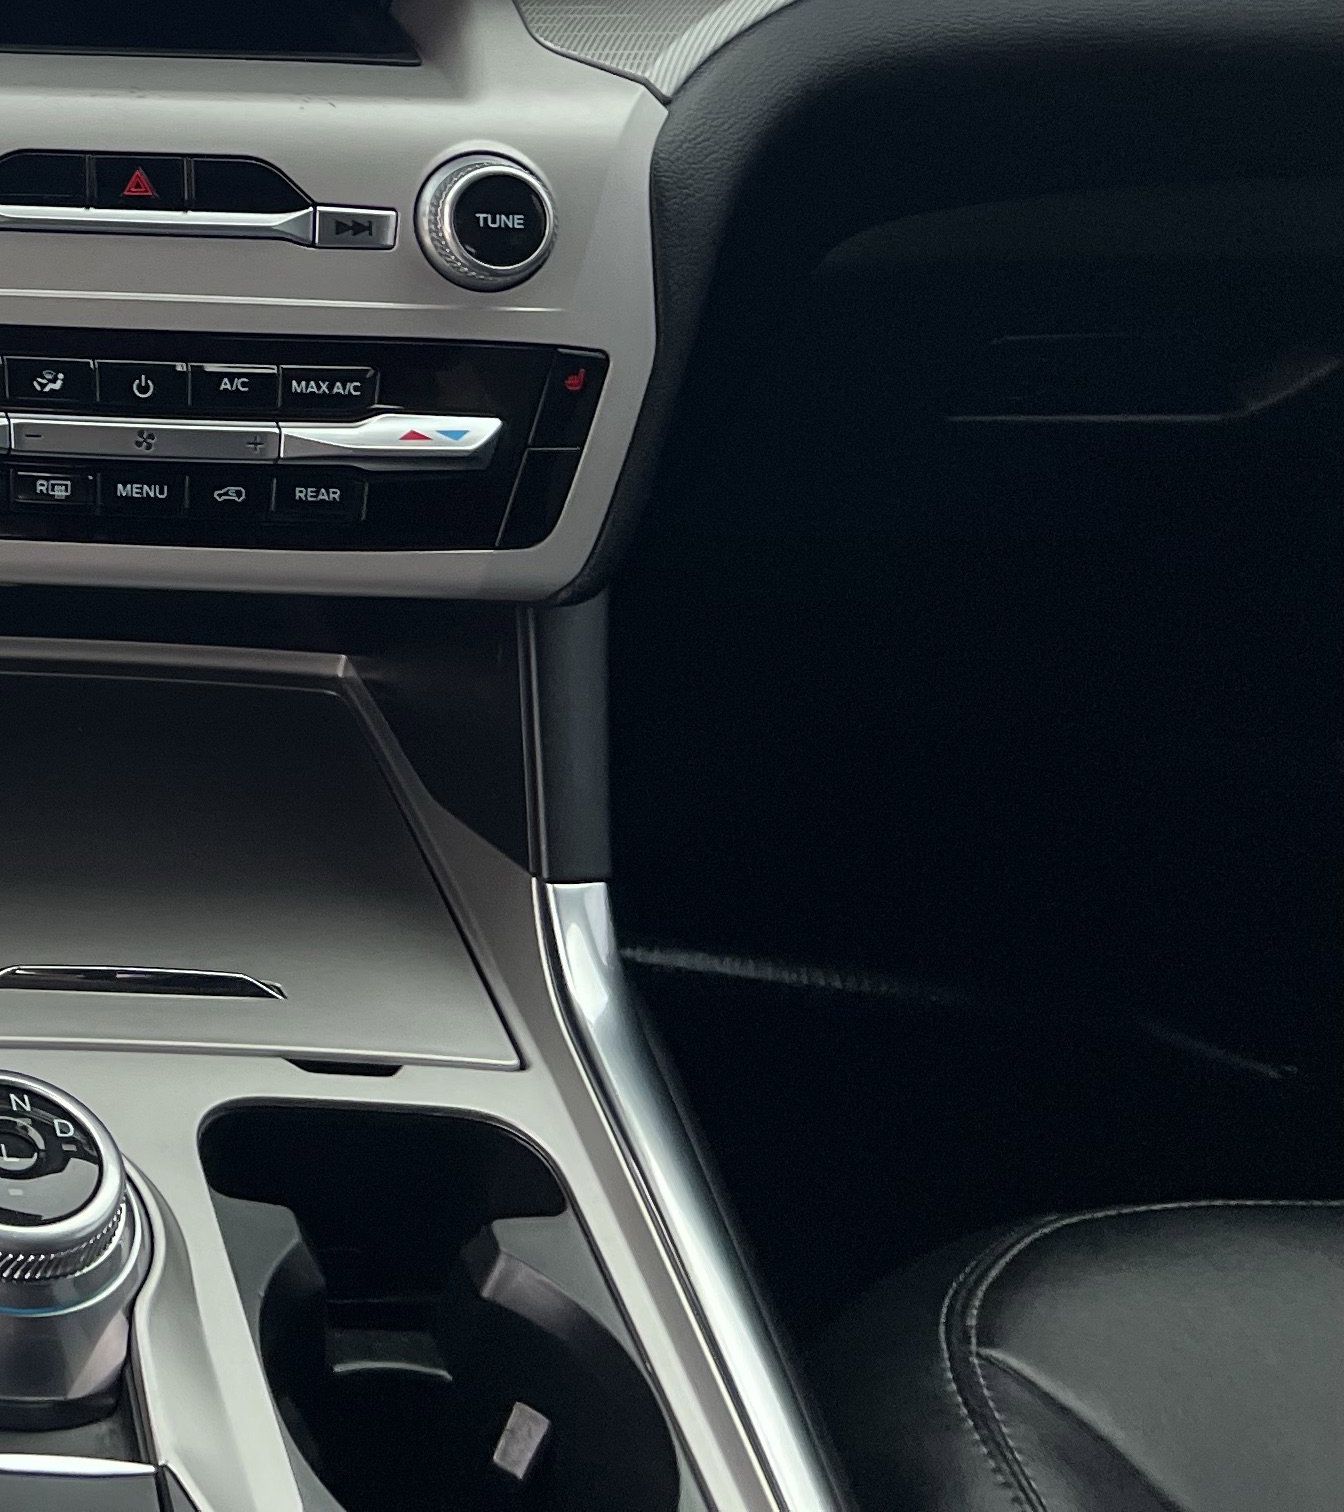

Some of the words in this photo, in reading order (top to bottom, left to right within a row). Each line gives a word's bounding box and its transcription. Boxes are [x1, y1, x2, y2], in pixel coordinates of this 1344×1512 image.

[475, 213, 525, 229] TUNE
[219, 376, 250, 393] A/C
[291, 379, 330, 395] MAX
[332, 381, 361, 397] A/C
[116, 483, 168, 499] MENU
[295, 487, 341, 503] REAR
[9, 1094, 32, 1111] N
[53, 1119, 75, 1138] D
[0, 1143, 20, 1162] L
